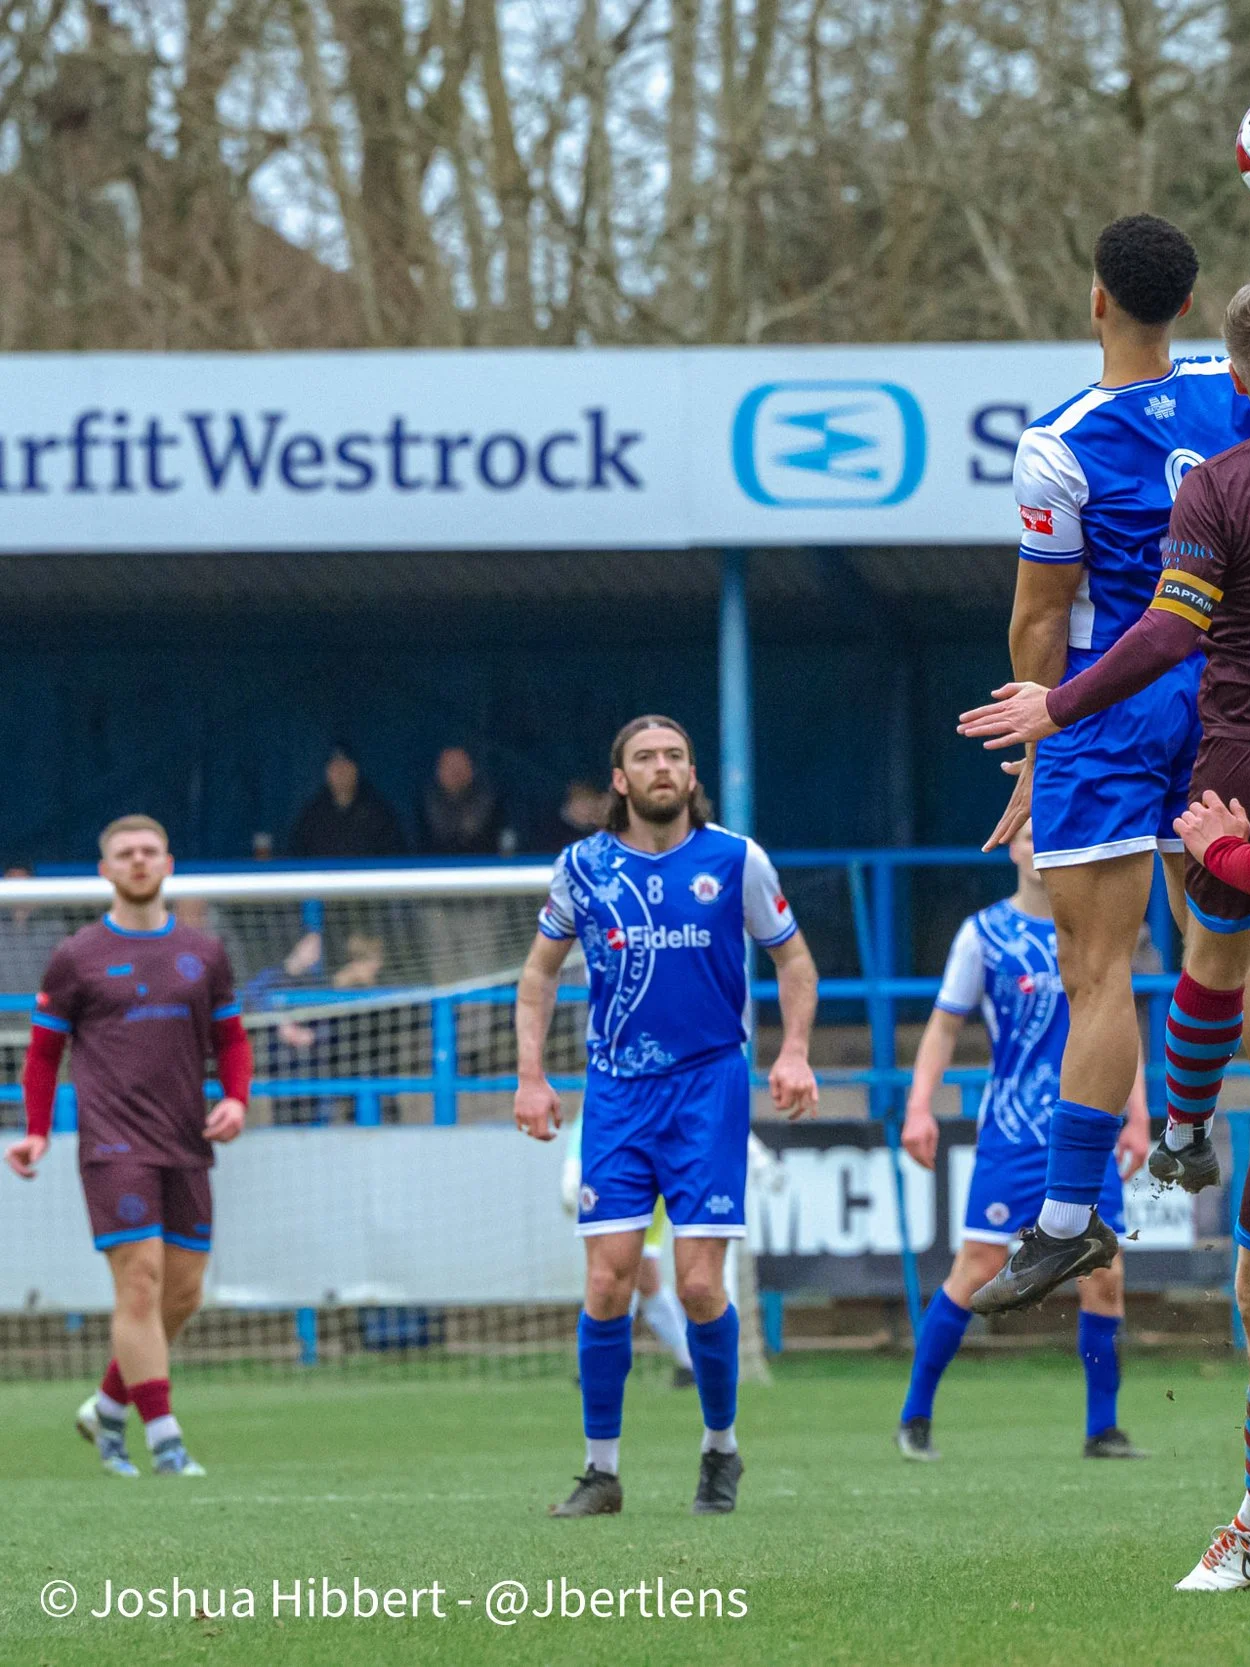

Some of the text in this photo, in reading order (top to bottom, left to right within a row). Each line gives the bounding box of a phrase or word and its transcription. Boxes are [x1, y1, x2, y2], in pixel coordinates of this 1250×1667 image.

[1164, 584, 1213, 612] CAPTAIN
[646, 875, 664, 906] 8
[626, 923, 712, 950] Fidelis
